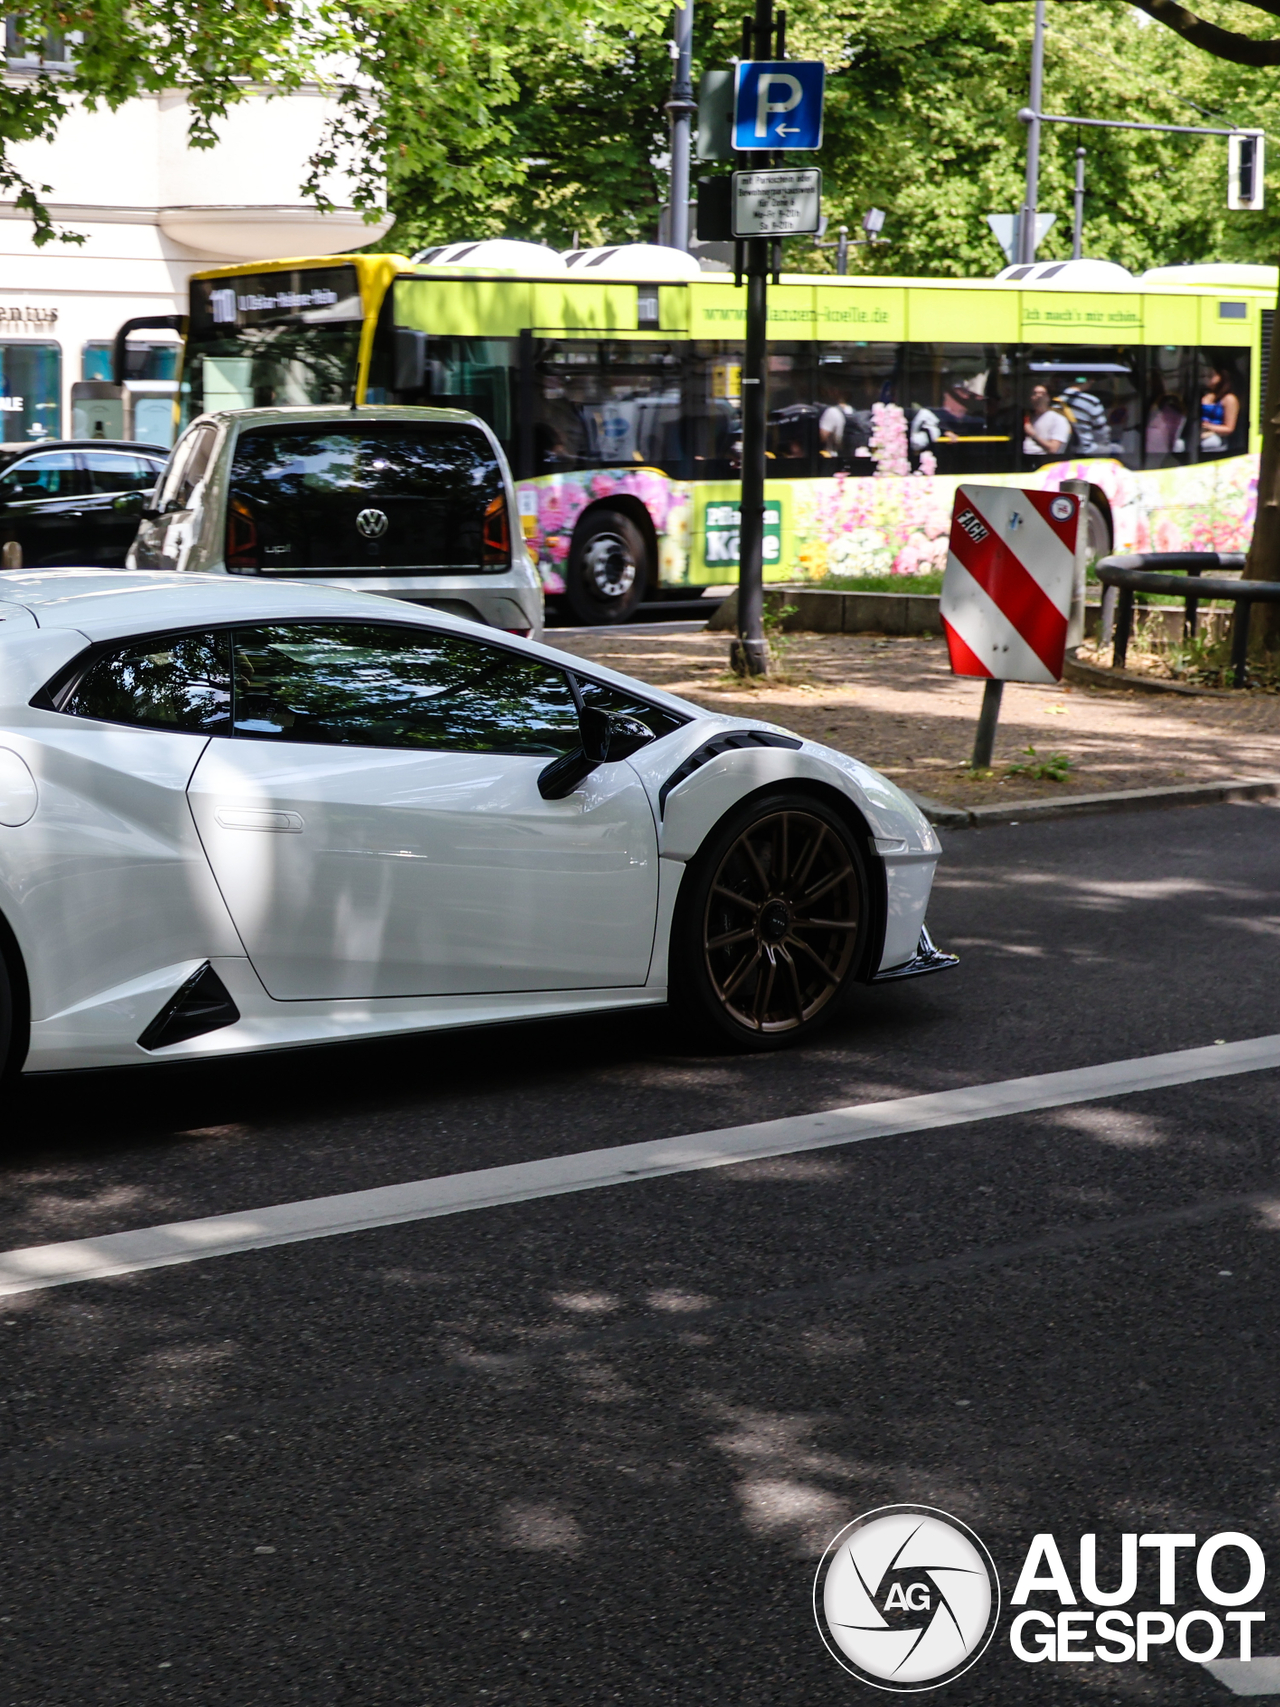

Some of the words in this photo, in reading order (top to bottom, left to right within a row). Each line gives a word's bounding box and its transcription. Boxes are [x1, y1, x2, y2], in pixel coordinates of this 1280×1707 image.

[754, 73, 803, 138] P
[756, 174, 794, 184] Parkschein
[771, 198, 788, 207] Zone
[359, 510, 386, 536] VW
[956, 509, 988, 543] FACH
